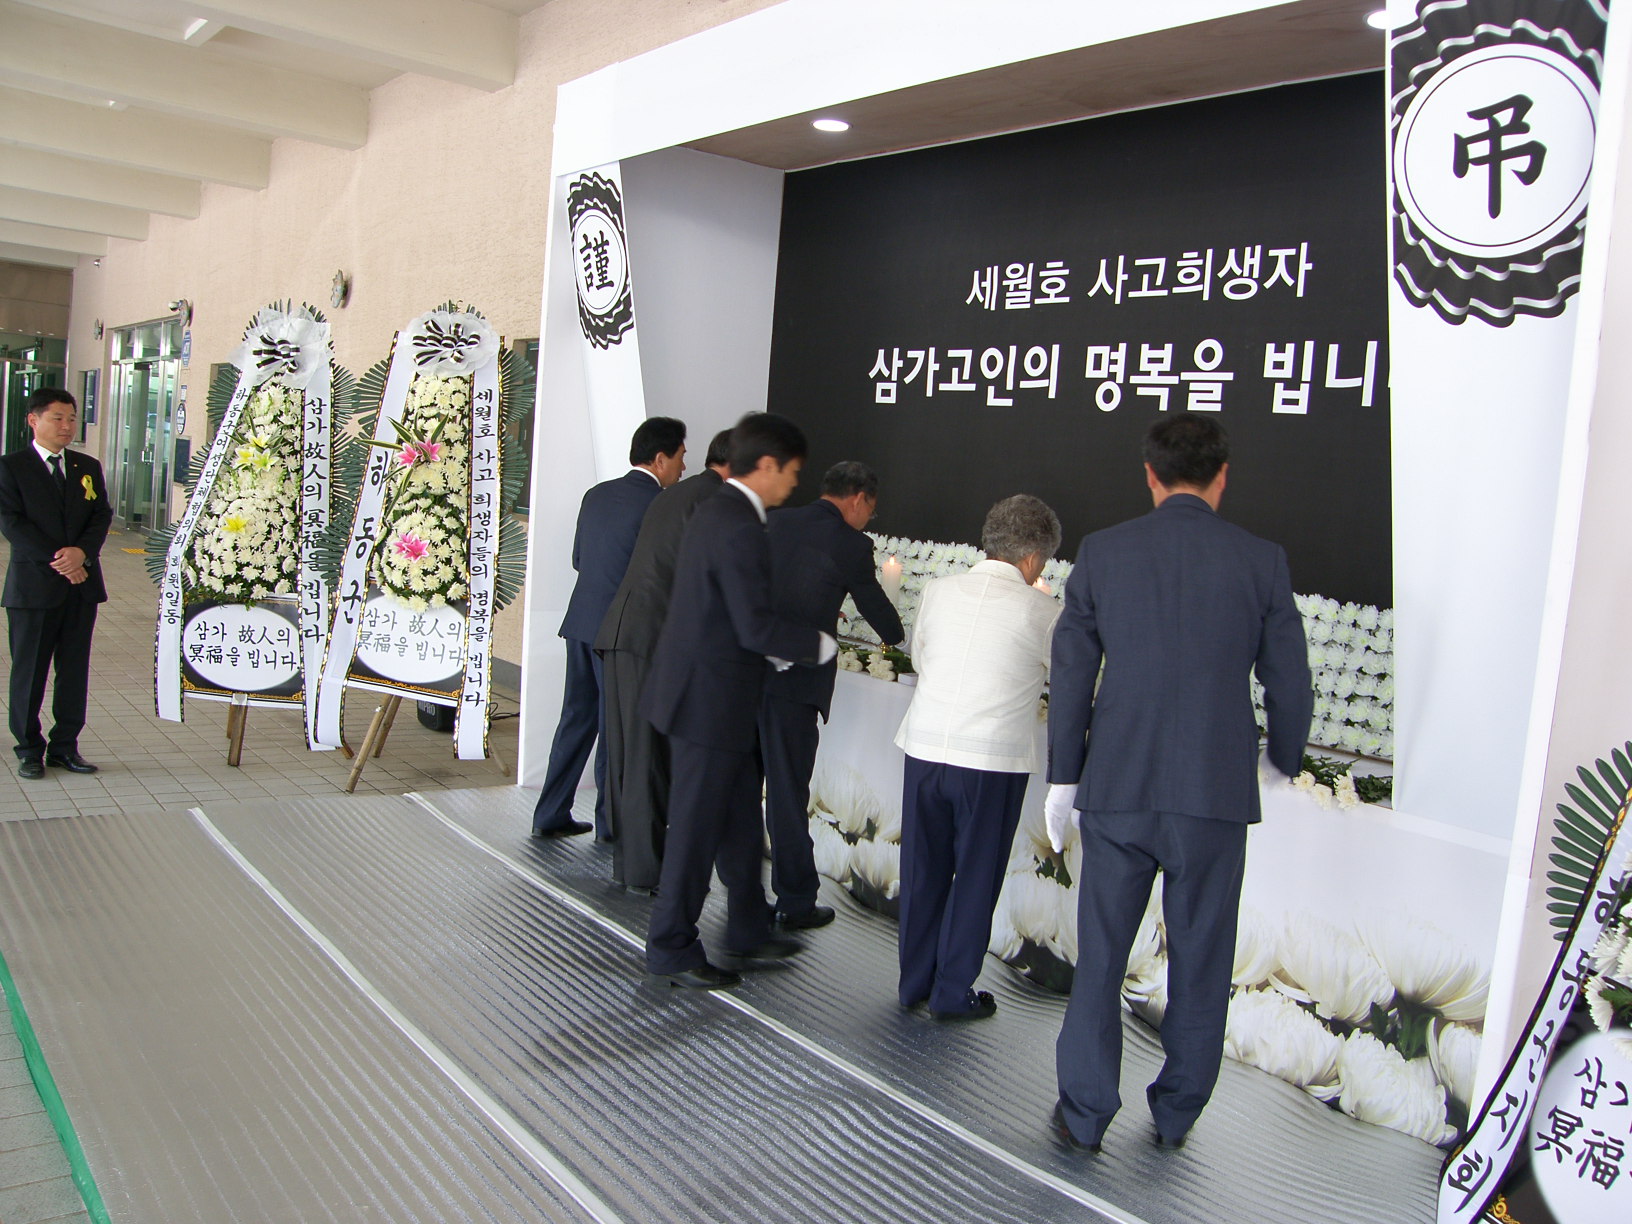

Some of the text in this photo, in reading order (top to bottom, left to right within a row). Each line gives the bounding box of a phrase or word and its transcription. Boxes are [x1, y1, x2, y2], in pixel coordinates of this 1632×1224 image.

[579, 230, 614, 292] 謹
[966, 242, 1313, 311] 세월호 사고희생자
[868, 338, 1379, 414] 삼가고인의 명복을 빕니
[305, 397, 328, 435] 삼가
[303, 441, 328, 502] 故人의
[341, 450, 389, 625] 하동군
[464, 388, 496, 708] 세월호 사고 희생자들의 명복을 빕니다
[194, 620, 291, 648] 삼가 故人의
[302, 580, 325, 644] 빕니다
[364, 607, 462, 642] 삼가 故人의
[188, 643, 241, 667] 冥福을
[415, 640, 465, 668] 빕니다
[1535, 1104, 1632, 1191] 冥福
